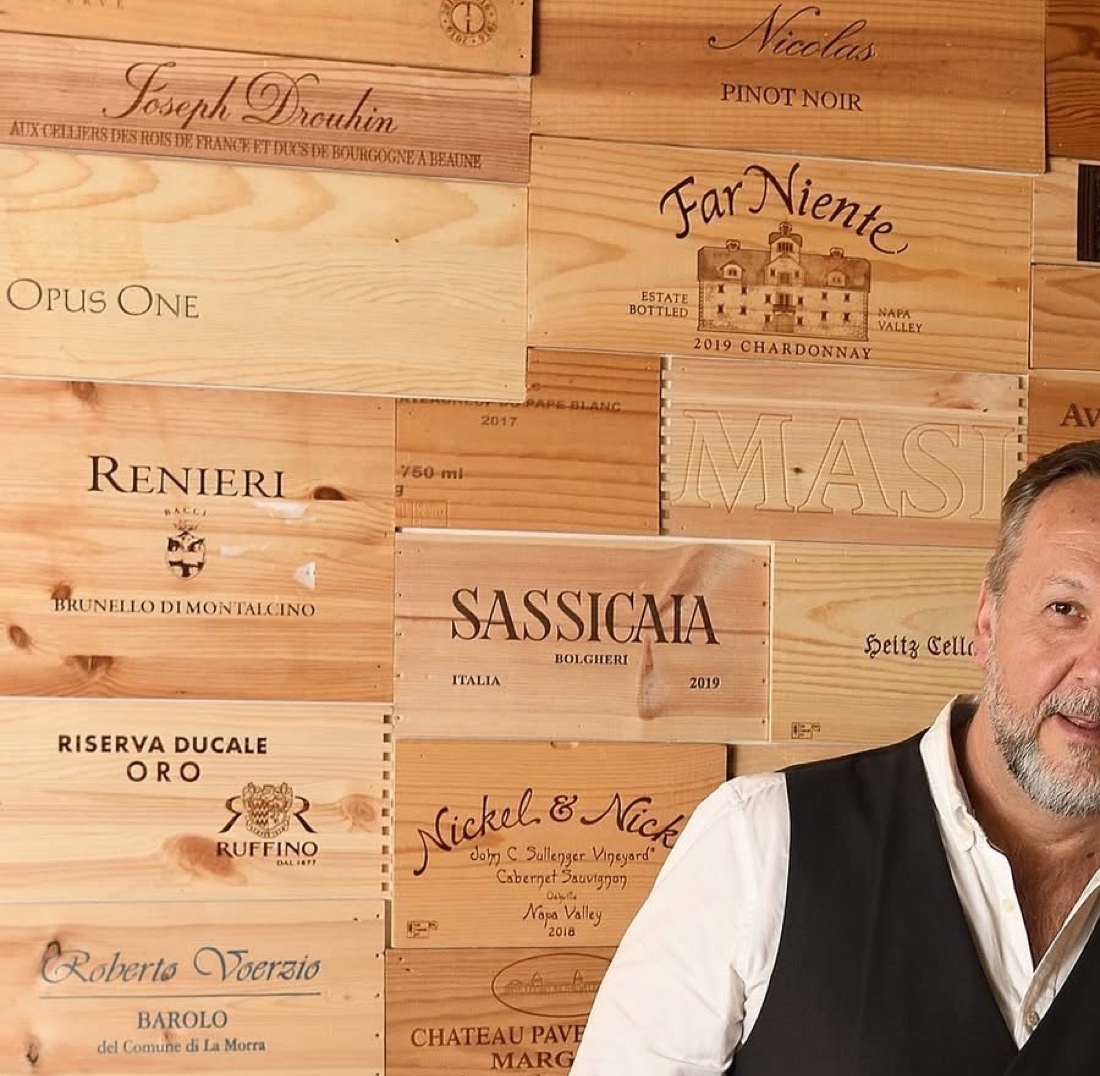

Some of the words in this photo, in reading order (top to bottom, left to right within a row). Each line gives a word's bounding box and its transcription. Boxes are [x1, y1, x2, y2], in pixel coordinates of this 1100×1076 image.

[708, 3, 877, 62] Nicolas
[101, 61, 238, 130] Joseph
[241, 71, 398, 134] Drouhin
[720, 83, 797, 107] PINOT
[802, 90, 863, 112] NOIR
[10, 121, 40, 137] AUX
[42, 123, 108, 141] CELLIERS
[111, 127, 139, 144] DES
[140, 130, 173, 147] ROIS
[175, 132, 193, 149] DE
[195, 134, 250, 153] FRANCE
[253, 138, 271, 154] ET
[274, 140, 308, 157] DUCS
[310, 143, 330, 159] DE
[332, 145, 415, 166] BOURGOGNE
[430, 151, 482, 169] BEAUNE
[660, 176, 742, 239] Far
[745, 162, 909, 255] Niente
[642, 290, 689, 305] ESTATE
[629, 303, 689, 318] BOTTLED
[878, 307, 911, 320] NAPA
[878, 320, 924, 334] VALLEY
[693, 337, 733, 354] 2019
[740, 339, 872, 360] CHARDONNAY
[481, 414, 518, 427] 2017
[400, 464, 435, 480] 750
[671, 409, 1015, 520] MASI
[87, 454, 286, 499] RENIERI
[54, 598, 156, 615] BRUNELLO
[160, 599, 182, 615] DI
[186, 600, 316, 618] MONTALCINO
[450, 585, 720, 645] SASSICAIA
[864, 633, 920, 659] Heitz
[554, 652, 629, 666] BOLGHERI
[451, 674, 501, 687] ITALIA
[689, 676, 721, 690] 2019
[58, 734, 166, 754] RISERVA
[174, 736, 268, 755] DUCALE
[126, 760, 201, 783] ORO
[412, 787, 541, 876] Nickel
[549, 794, 578, 822] &
[216, 841, 319, 859] RUFFINO
[495, 869, 558, 887] Cabernet
[561, 869, 628, 890] Sauvignon
[522, 902, 559, 930] Napa
[564, 903, 602, 927] Valley
[548, 925, 576, 938] 2018
[40, 949, 178, 984] Roberto
[193, 946, 322, 984] Voerzio
[137, 1010, 229, 1030] BAROLO
[97, 1038, 119, 1054] del
[122, 1040, 182, 1054] Comune
[185, 1038, 200, 1053] di
[203, 1038, 221, 1052] La
[224, 1038, 267, 1053] Morra
[410, 1025, 525, 1047] CHATEAU
